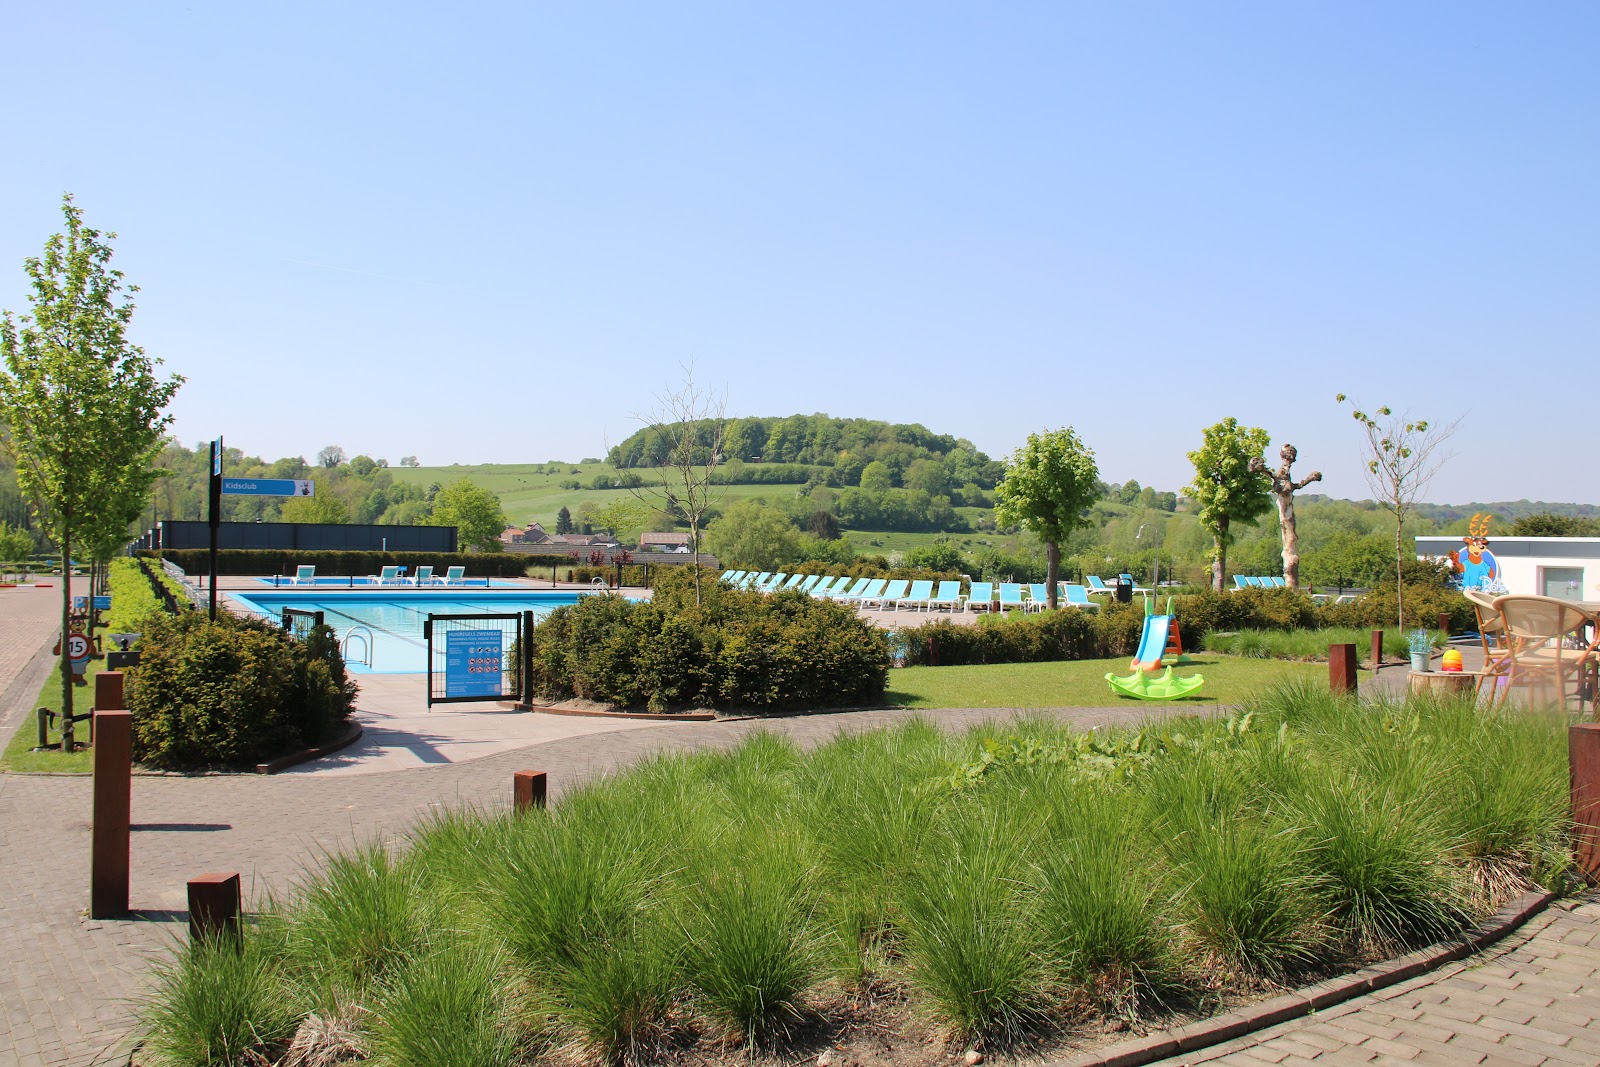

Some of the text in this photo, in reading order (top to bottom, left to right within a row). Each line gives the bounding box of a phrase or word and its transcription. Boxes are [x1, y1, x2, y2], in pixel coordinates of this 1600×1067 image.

[225, 482, 257, 490] Kidsclub
[75, 597, 83, 608] P
[69, 641, 83, 653] 15
